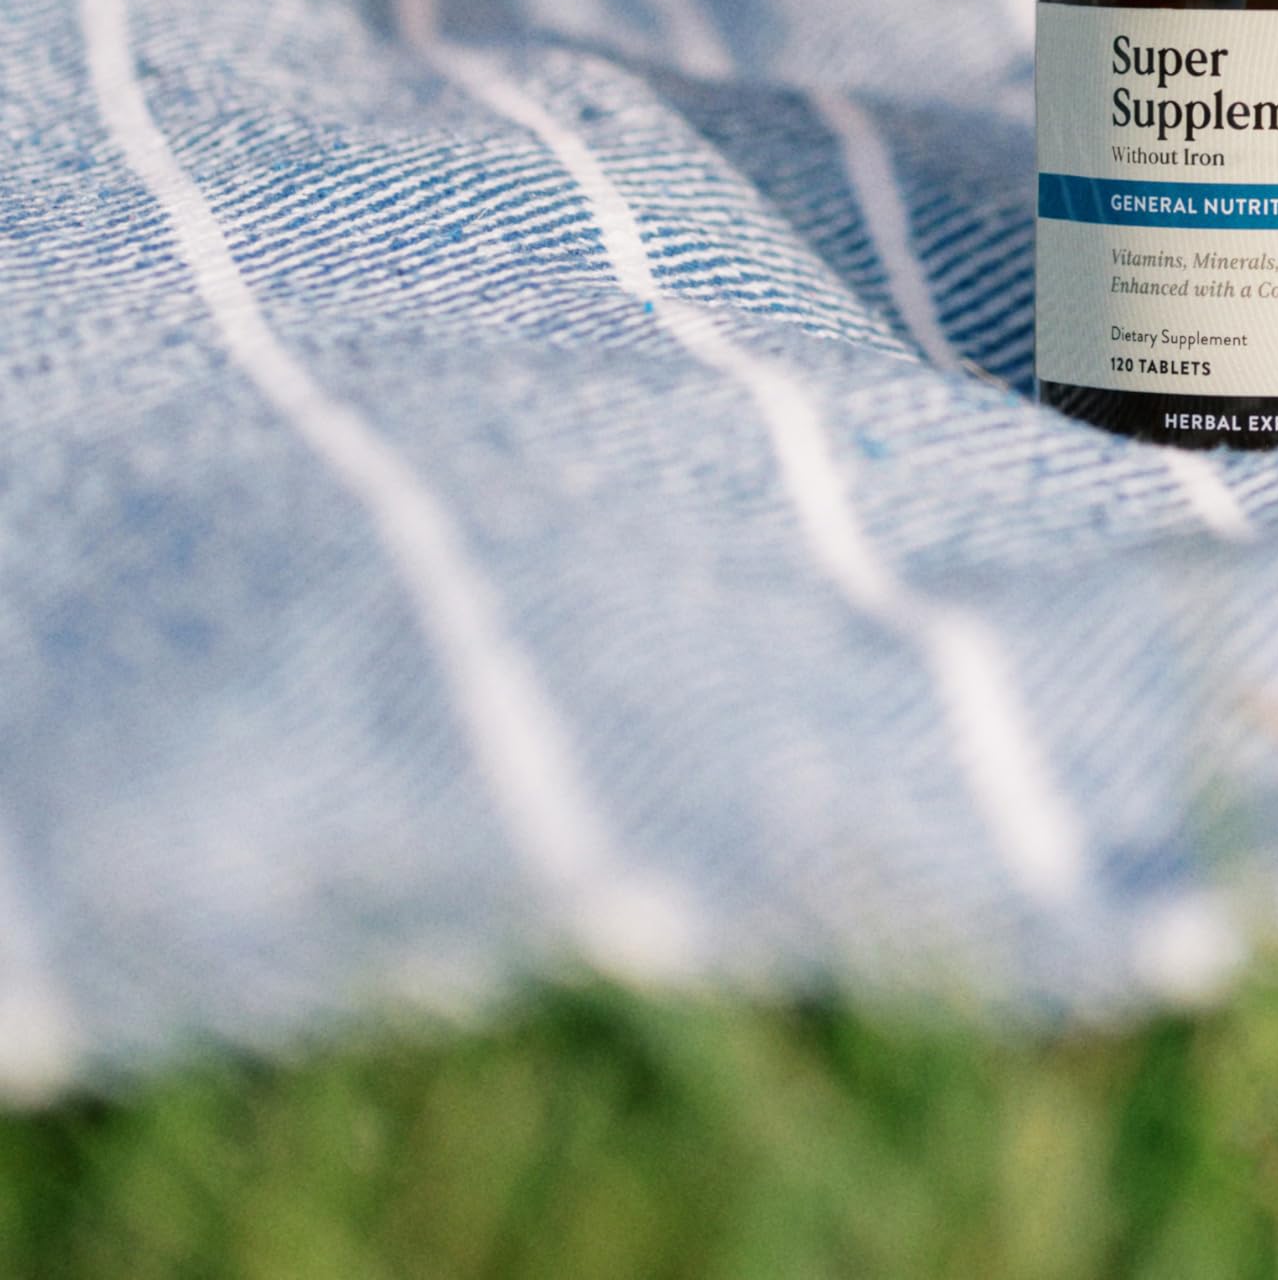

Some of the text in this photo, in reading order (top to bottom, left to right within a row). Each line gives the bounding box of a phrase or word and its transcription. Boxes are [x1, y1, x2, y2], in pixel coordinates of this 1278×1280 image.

[1112, 35, 1228, 88] Super
[1111, 147, 1225, 166] Without Iron
[1110, 194, 1197, 213] GENERAL
[1110, 249, 1187, 271] Vitamins,
[1110, 276, 1189, 297] Enhanced
[1194, 279, 1235, 298] with
[1240, 285, 1252, 298] a
[1110, 326, 1248, 350] Dietary Supplement
[1110, 357, 1211, 376] 120 TABLETS
[1165, 412, 1242, 431] HERBAL
